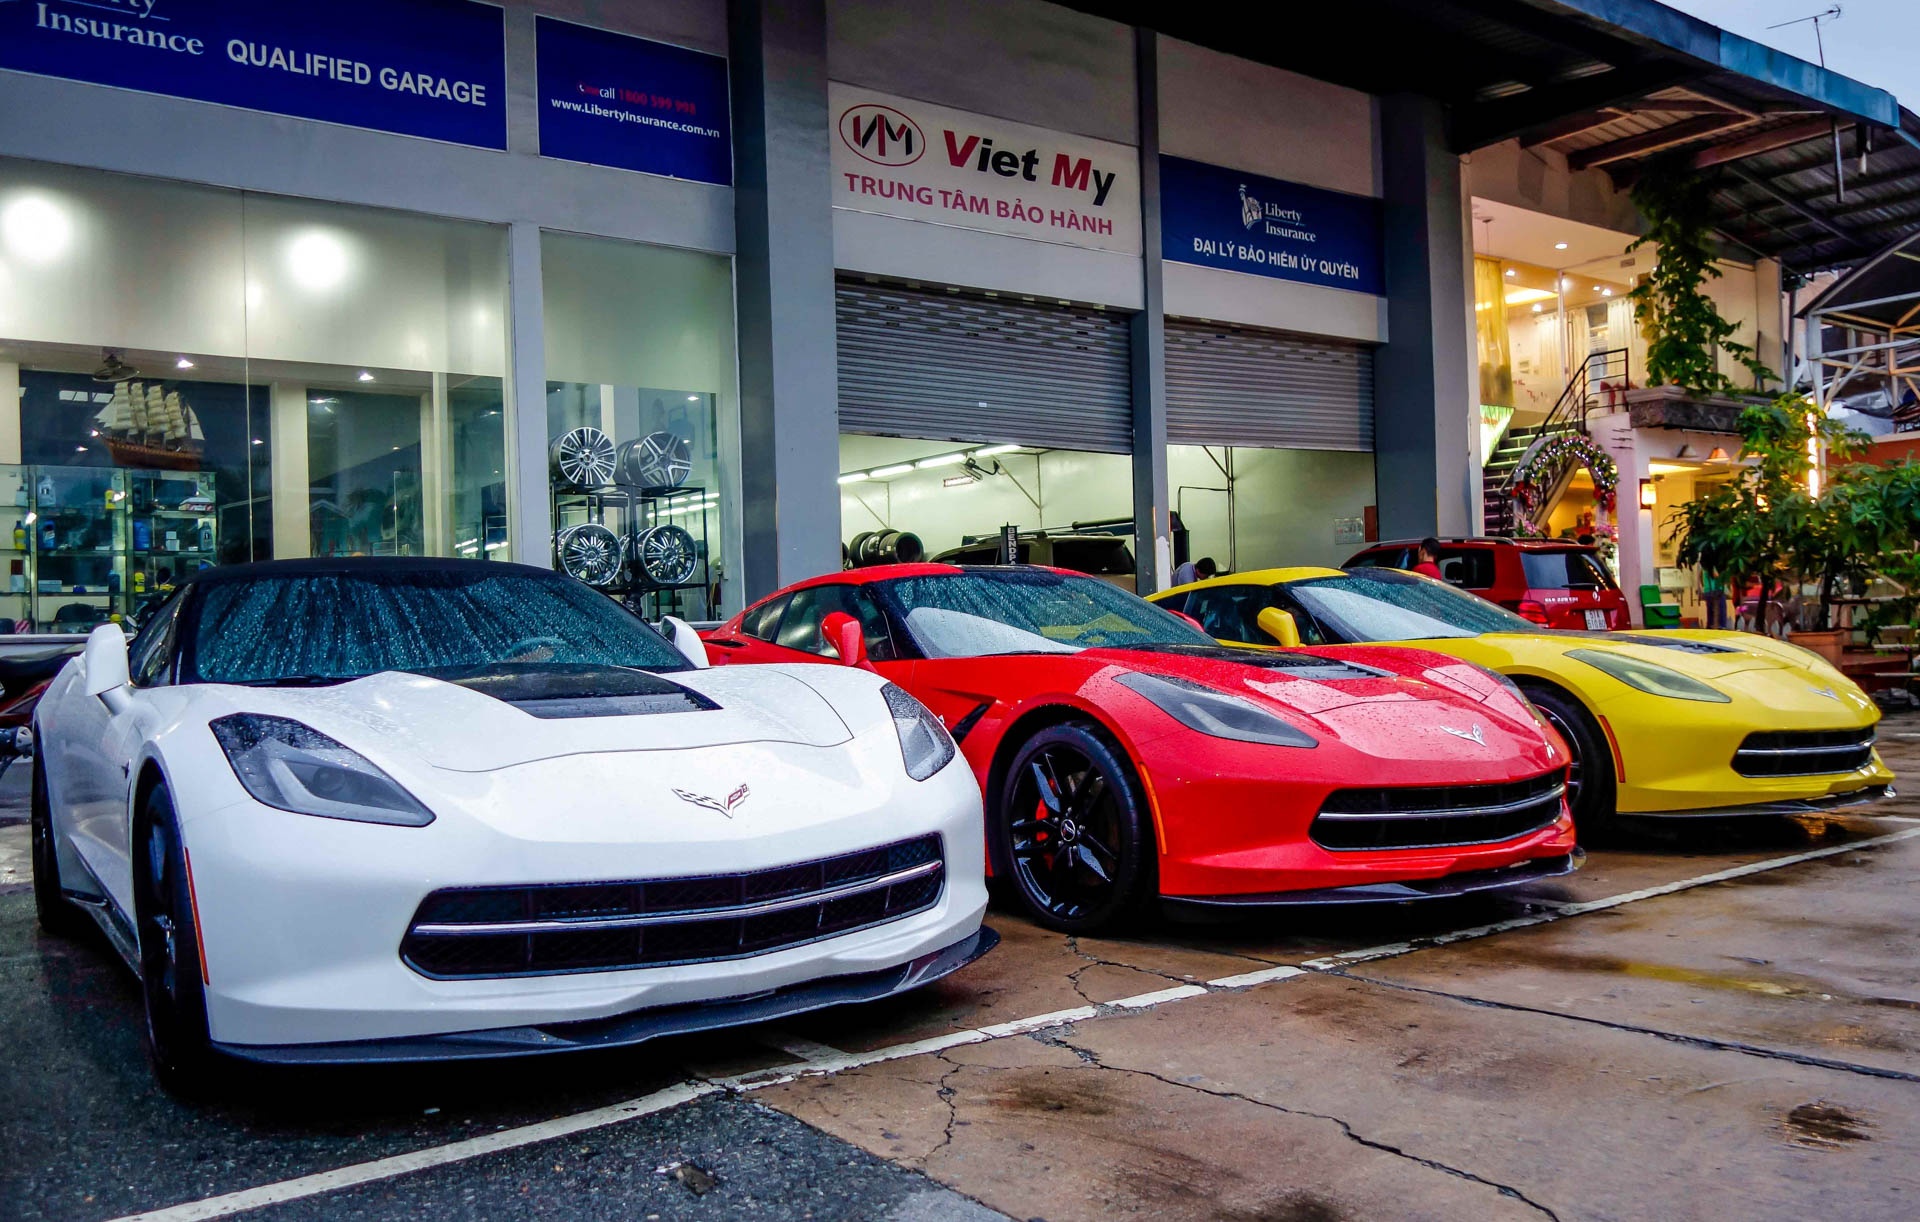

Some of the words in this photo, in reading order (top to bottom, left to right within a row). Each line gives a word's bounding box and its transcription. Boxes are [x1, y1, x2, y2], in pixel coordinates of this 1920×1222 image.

[36, 2, 204, 55] Insurance
[226, 38, 373, 85] QUALIFIED
[379, 67, 487, 107] GARAGE
[551, 98, 721, 139] www.LibertyInsurance.com.vn
[943, 129, 1040, 182] Viet
[1051, 153, 1116, 206] My
[844, 172, 933, 206] TRUNG
[938, 189, 990, 216] TÂM
[996, 198, 1045, 224] BẢO
[1050, 209, 1113, 236] HÀNH
[1265, 203, 1301, 226] Liberty
[1193, 237, 1216, 257] ĐẠI
[1219, 241, 1235, 258] LÝ
[1238, 244, 1266, 264] BẢO
[1266, 221, 1316, 242] Insurance
